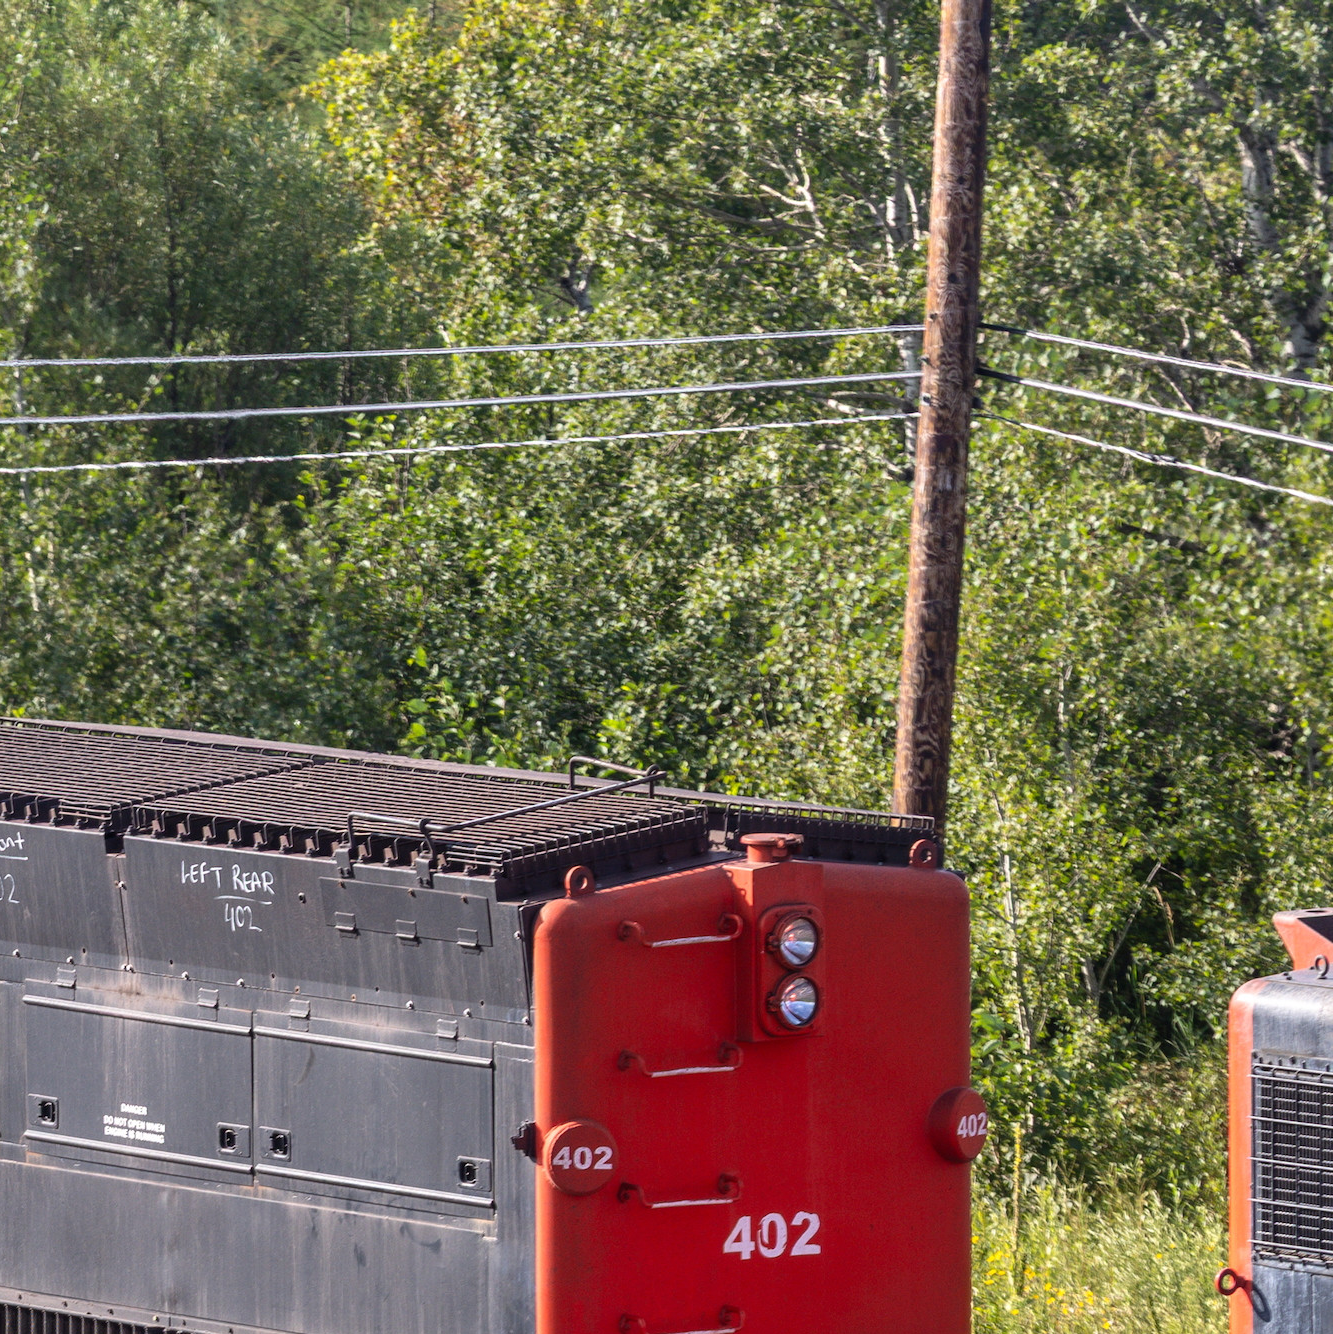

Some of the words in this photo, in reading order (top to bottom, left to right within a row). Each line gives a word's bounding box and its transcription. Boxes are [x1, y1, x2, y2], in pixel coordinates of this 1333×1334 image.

[181, 860, 222, 889] LEFT
[232, 864, 275, 895] REAR
[224, 903, 262, 932] 402
[955, 1112, 989, 1139] 402
[552, 1146, 613, 1171] 402
[722, 1210, 822, 1261] 402
